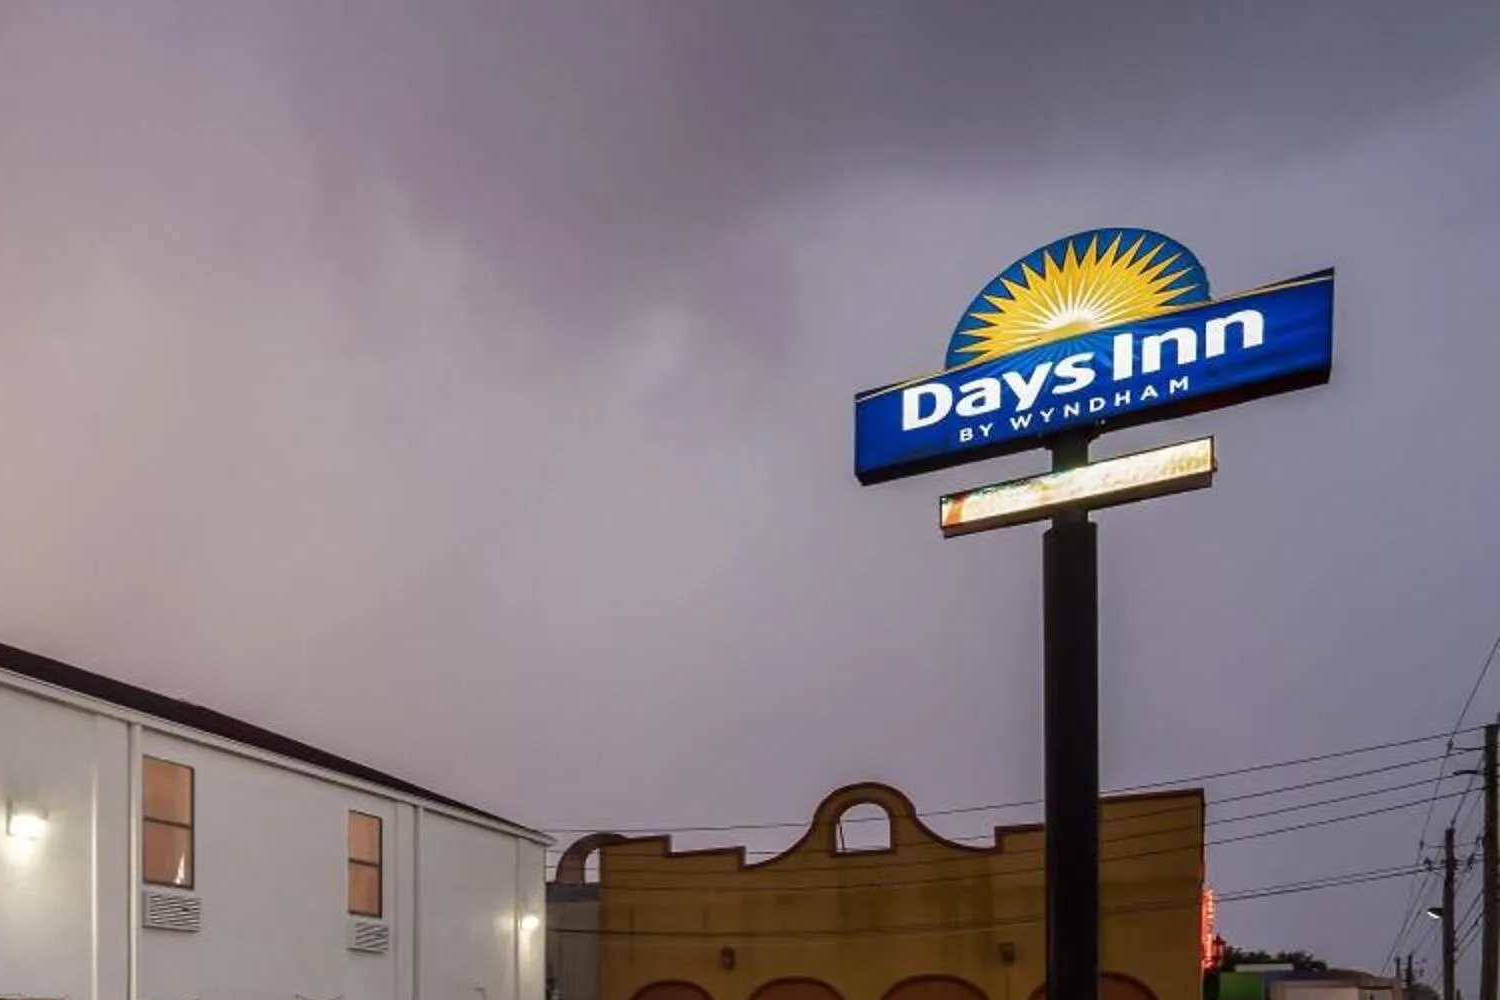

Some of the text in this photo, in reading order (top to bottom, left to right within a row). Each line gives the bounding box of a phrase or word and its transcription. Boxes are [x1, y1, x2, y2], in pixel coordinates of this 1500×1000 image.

[902, 309, 1264, 431] Days Inn
[959, 375, 1189, 443] BY WYNDHAM
